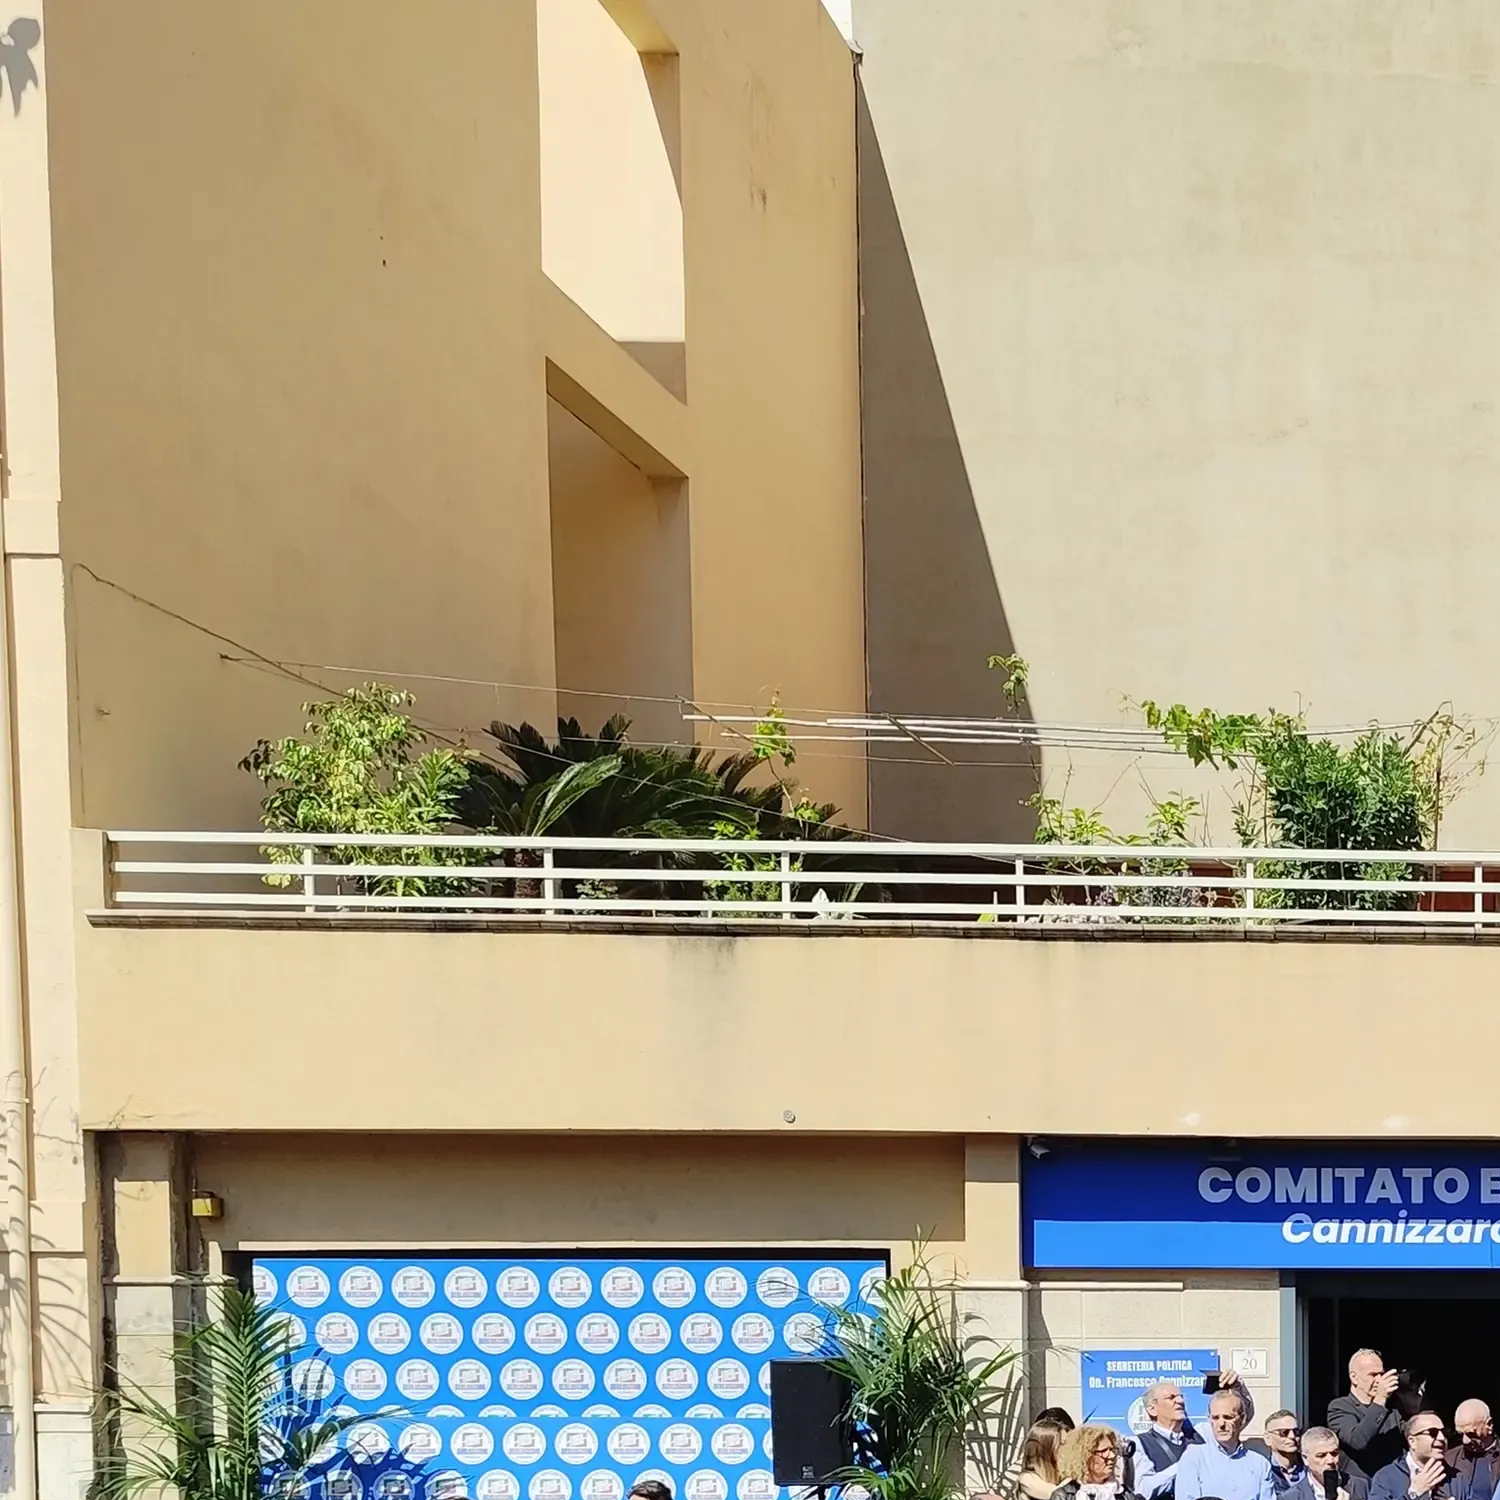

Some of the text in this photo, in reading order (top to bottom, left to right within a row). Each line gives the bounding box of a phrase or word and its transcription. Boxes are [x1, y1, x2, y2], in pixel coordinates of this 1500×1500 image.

[1197, 1166, 1470, 1204] COMITATO
[1106, 1360, 1193, 1372] SEGRETERIA POLITICA
[1242, 1358, 1257, 1370] 20
[1106, 1376, 1157, 1389] Francesco
